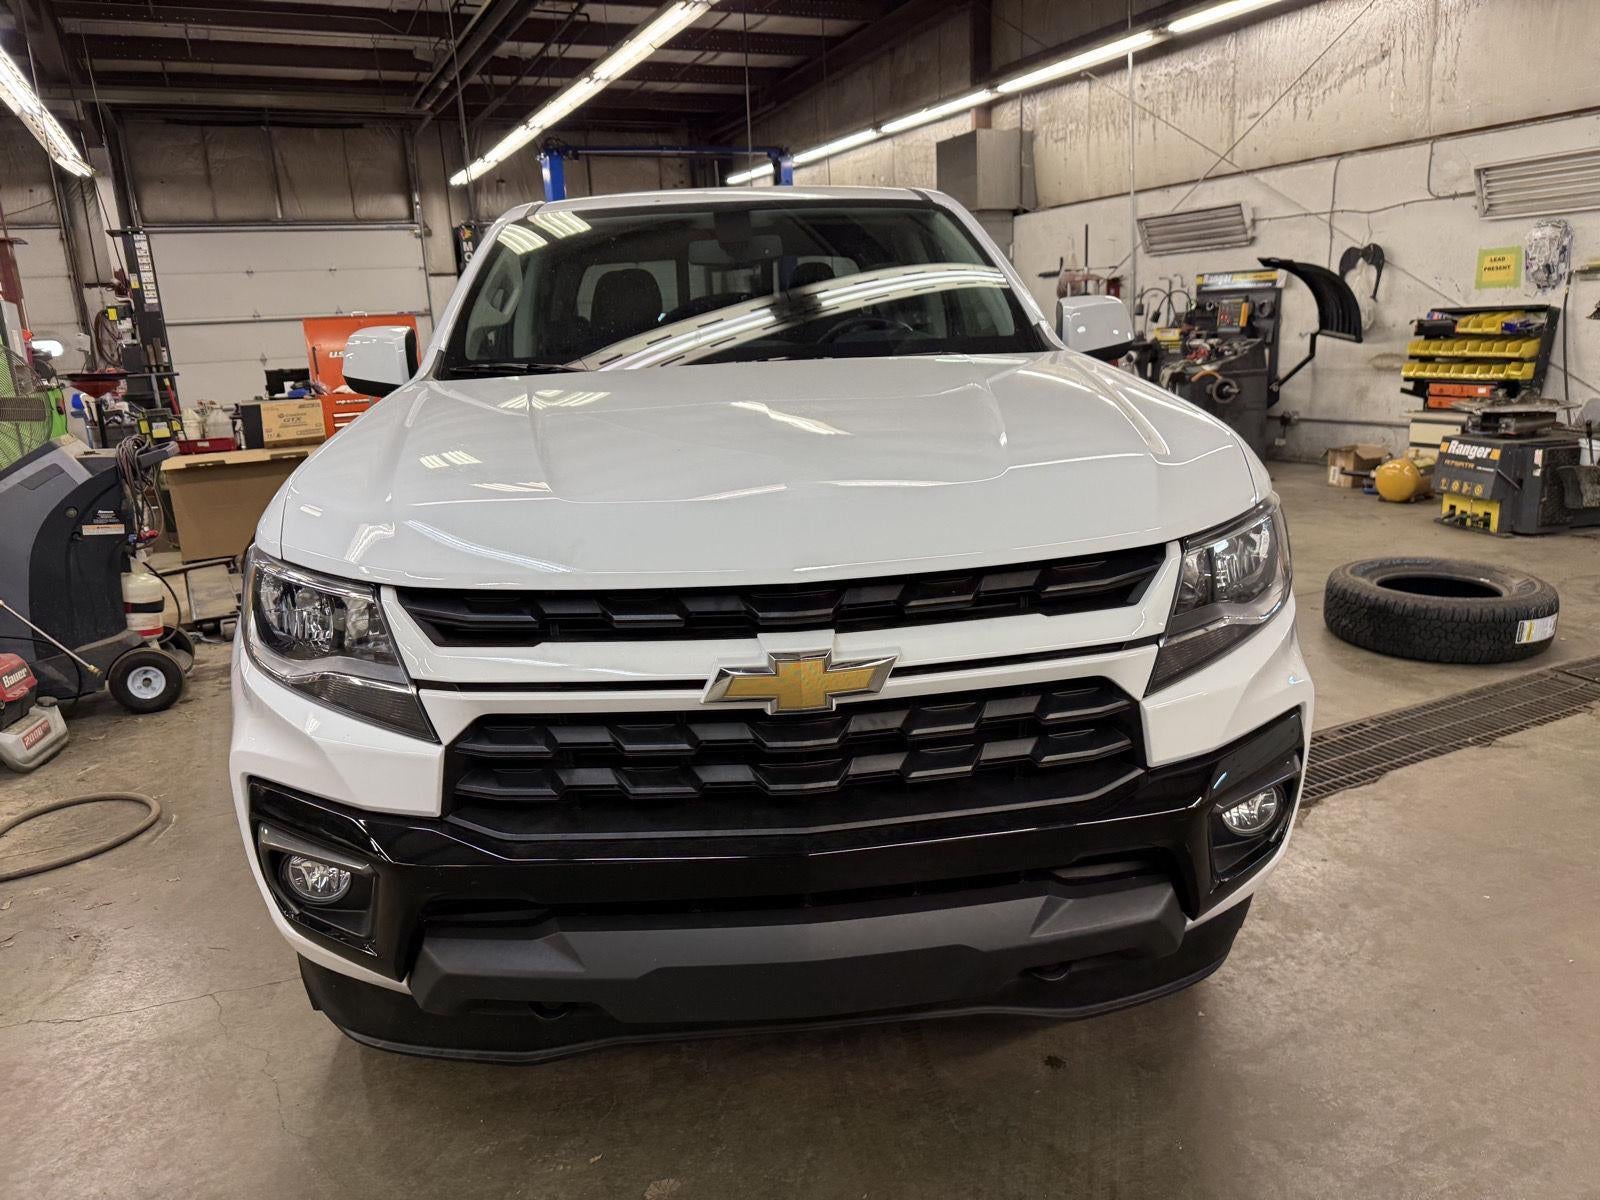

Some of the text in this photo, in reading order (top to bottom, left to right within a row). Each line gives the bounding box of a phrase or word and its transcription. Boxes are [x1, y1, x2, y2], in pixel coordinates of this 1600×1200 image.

[1483, 264, 1511, 272] PRESENT
[1447, 440, 1492, 460] Ranger
[2, 667, 28, 688] Bauer
[23, 726, 44, 747] 2000
